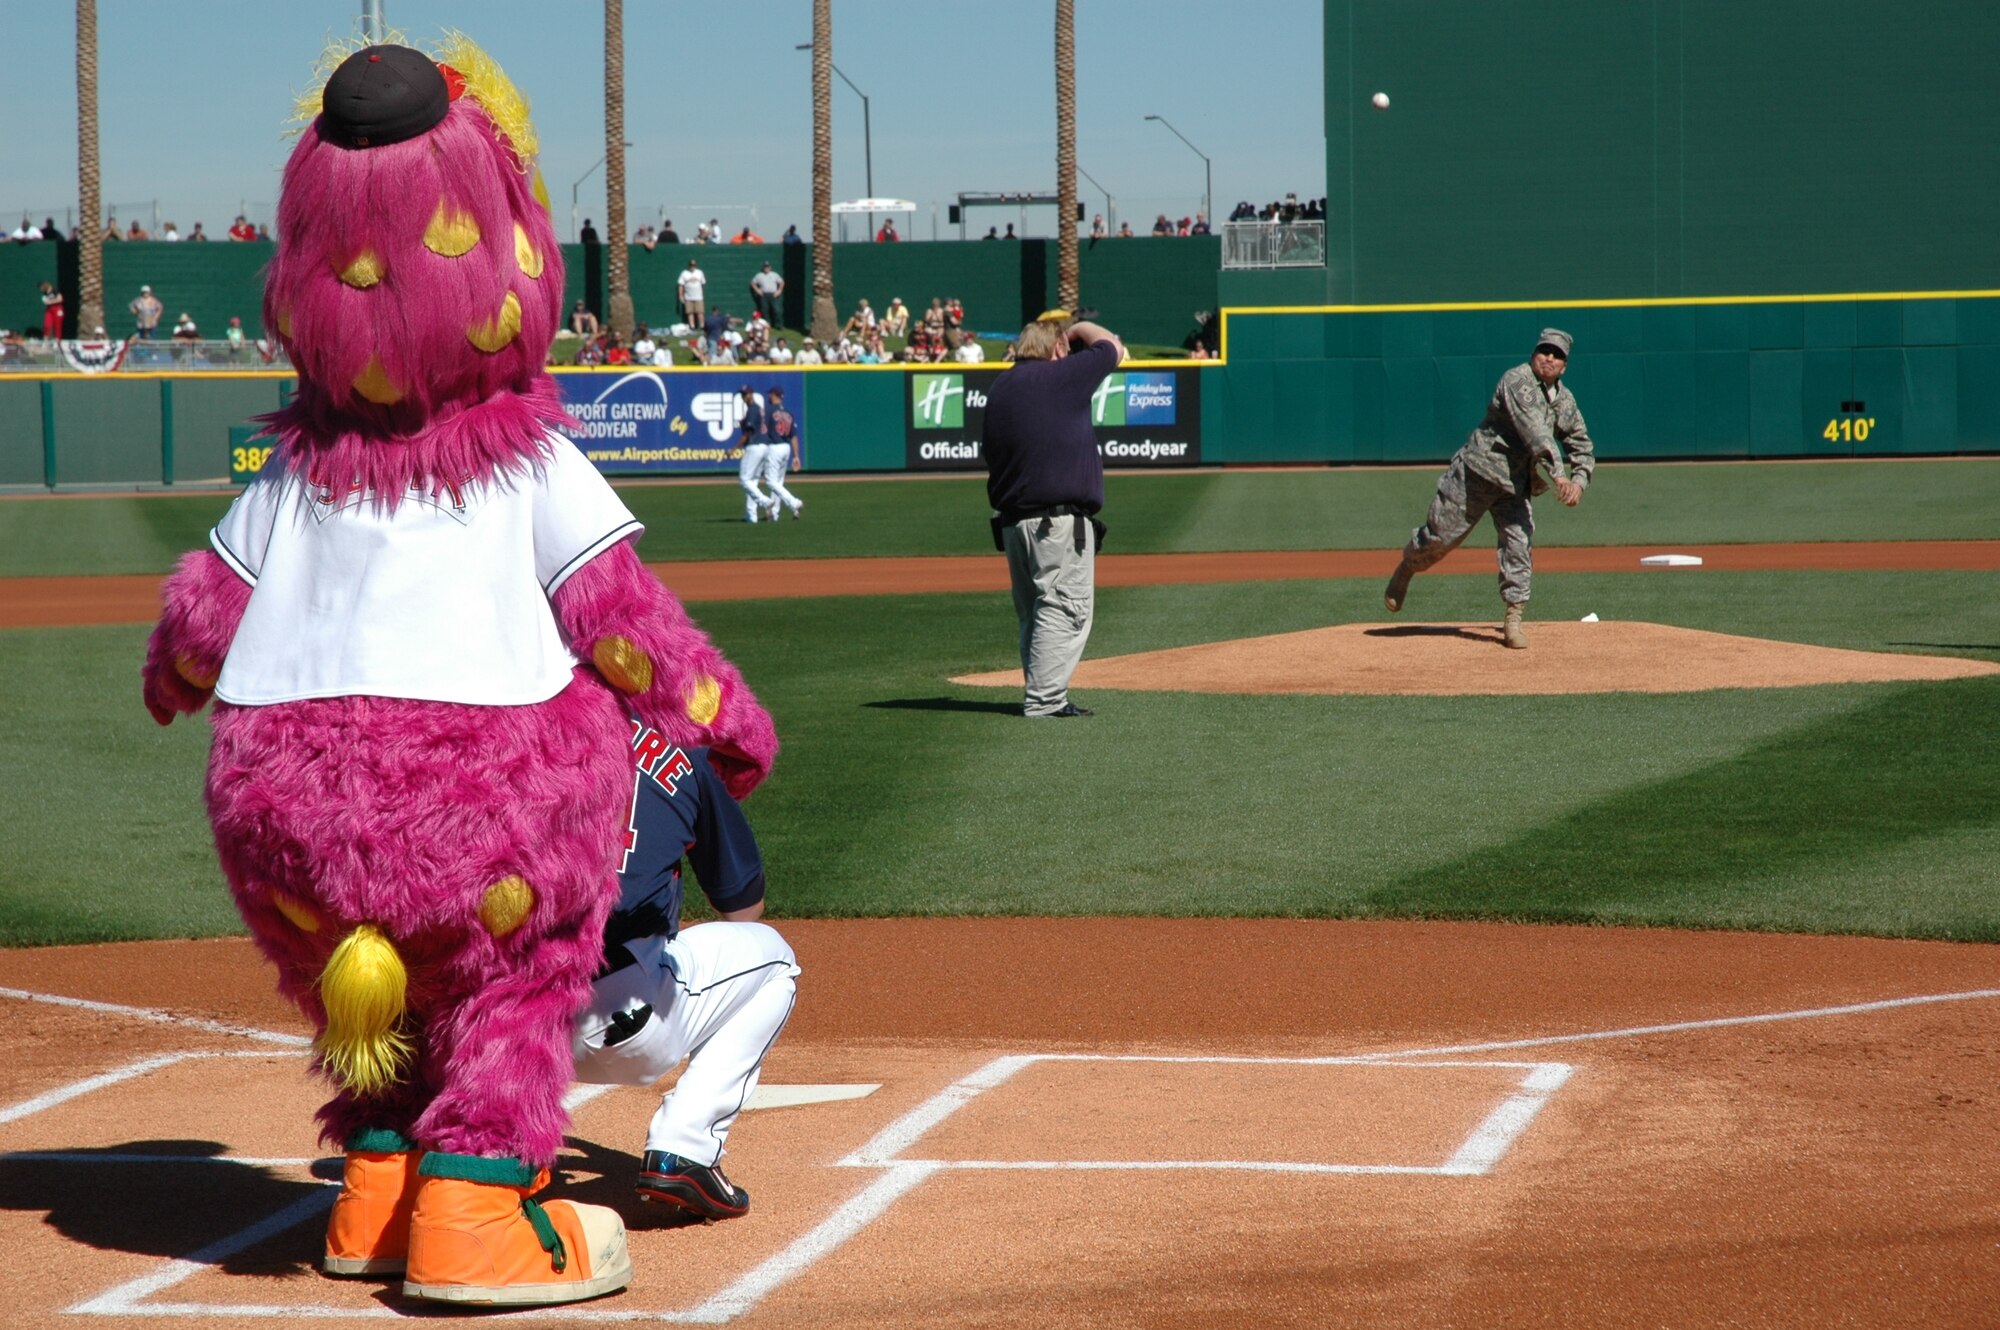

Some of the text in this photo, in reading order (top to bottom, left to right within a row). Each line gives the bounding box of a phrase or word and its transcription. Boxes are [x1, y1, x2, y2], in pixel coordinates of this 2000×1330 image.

[1128, 393, 1173, 409] Express
[562, 402, 668, 420] RPORT GATEWAY
[670, 415, 689, 435] by
[1823, 418, 1875, 442] 410'
[586, 447, 745, 463] www.AirportGateway.o
[920, 441, 979, 460] Official
[1104, 438, 1188, 461] Goodyear
